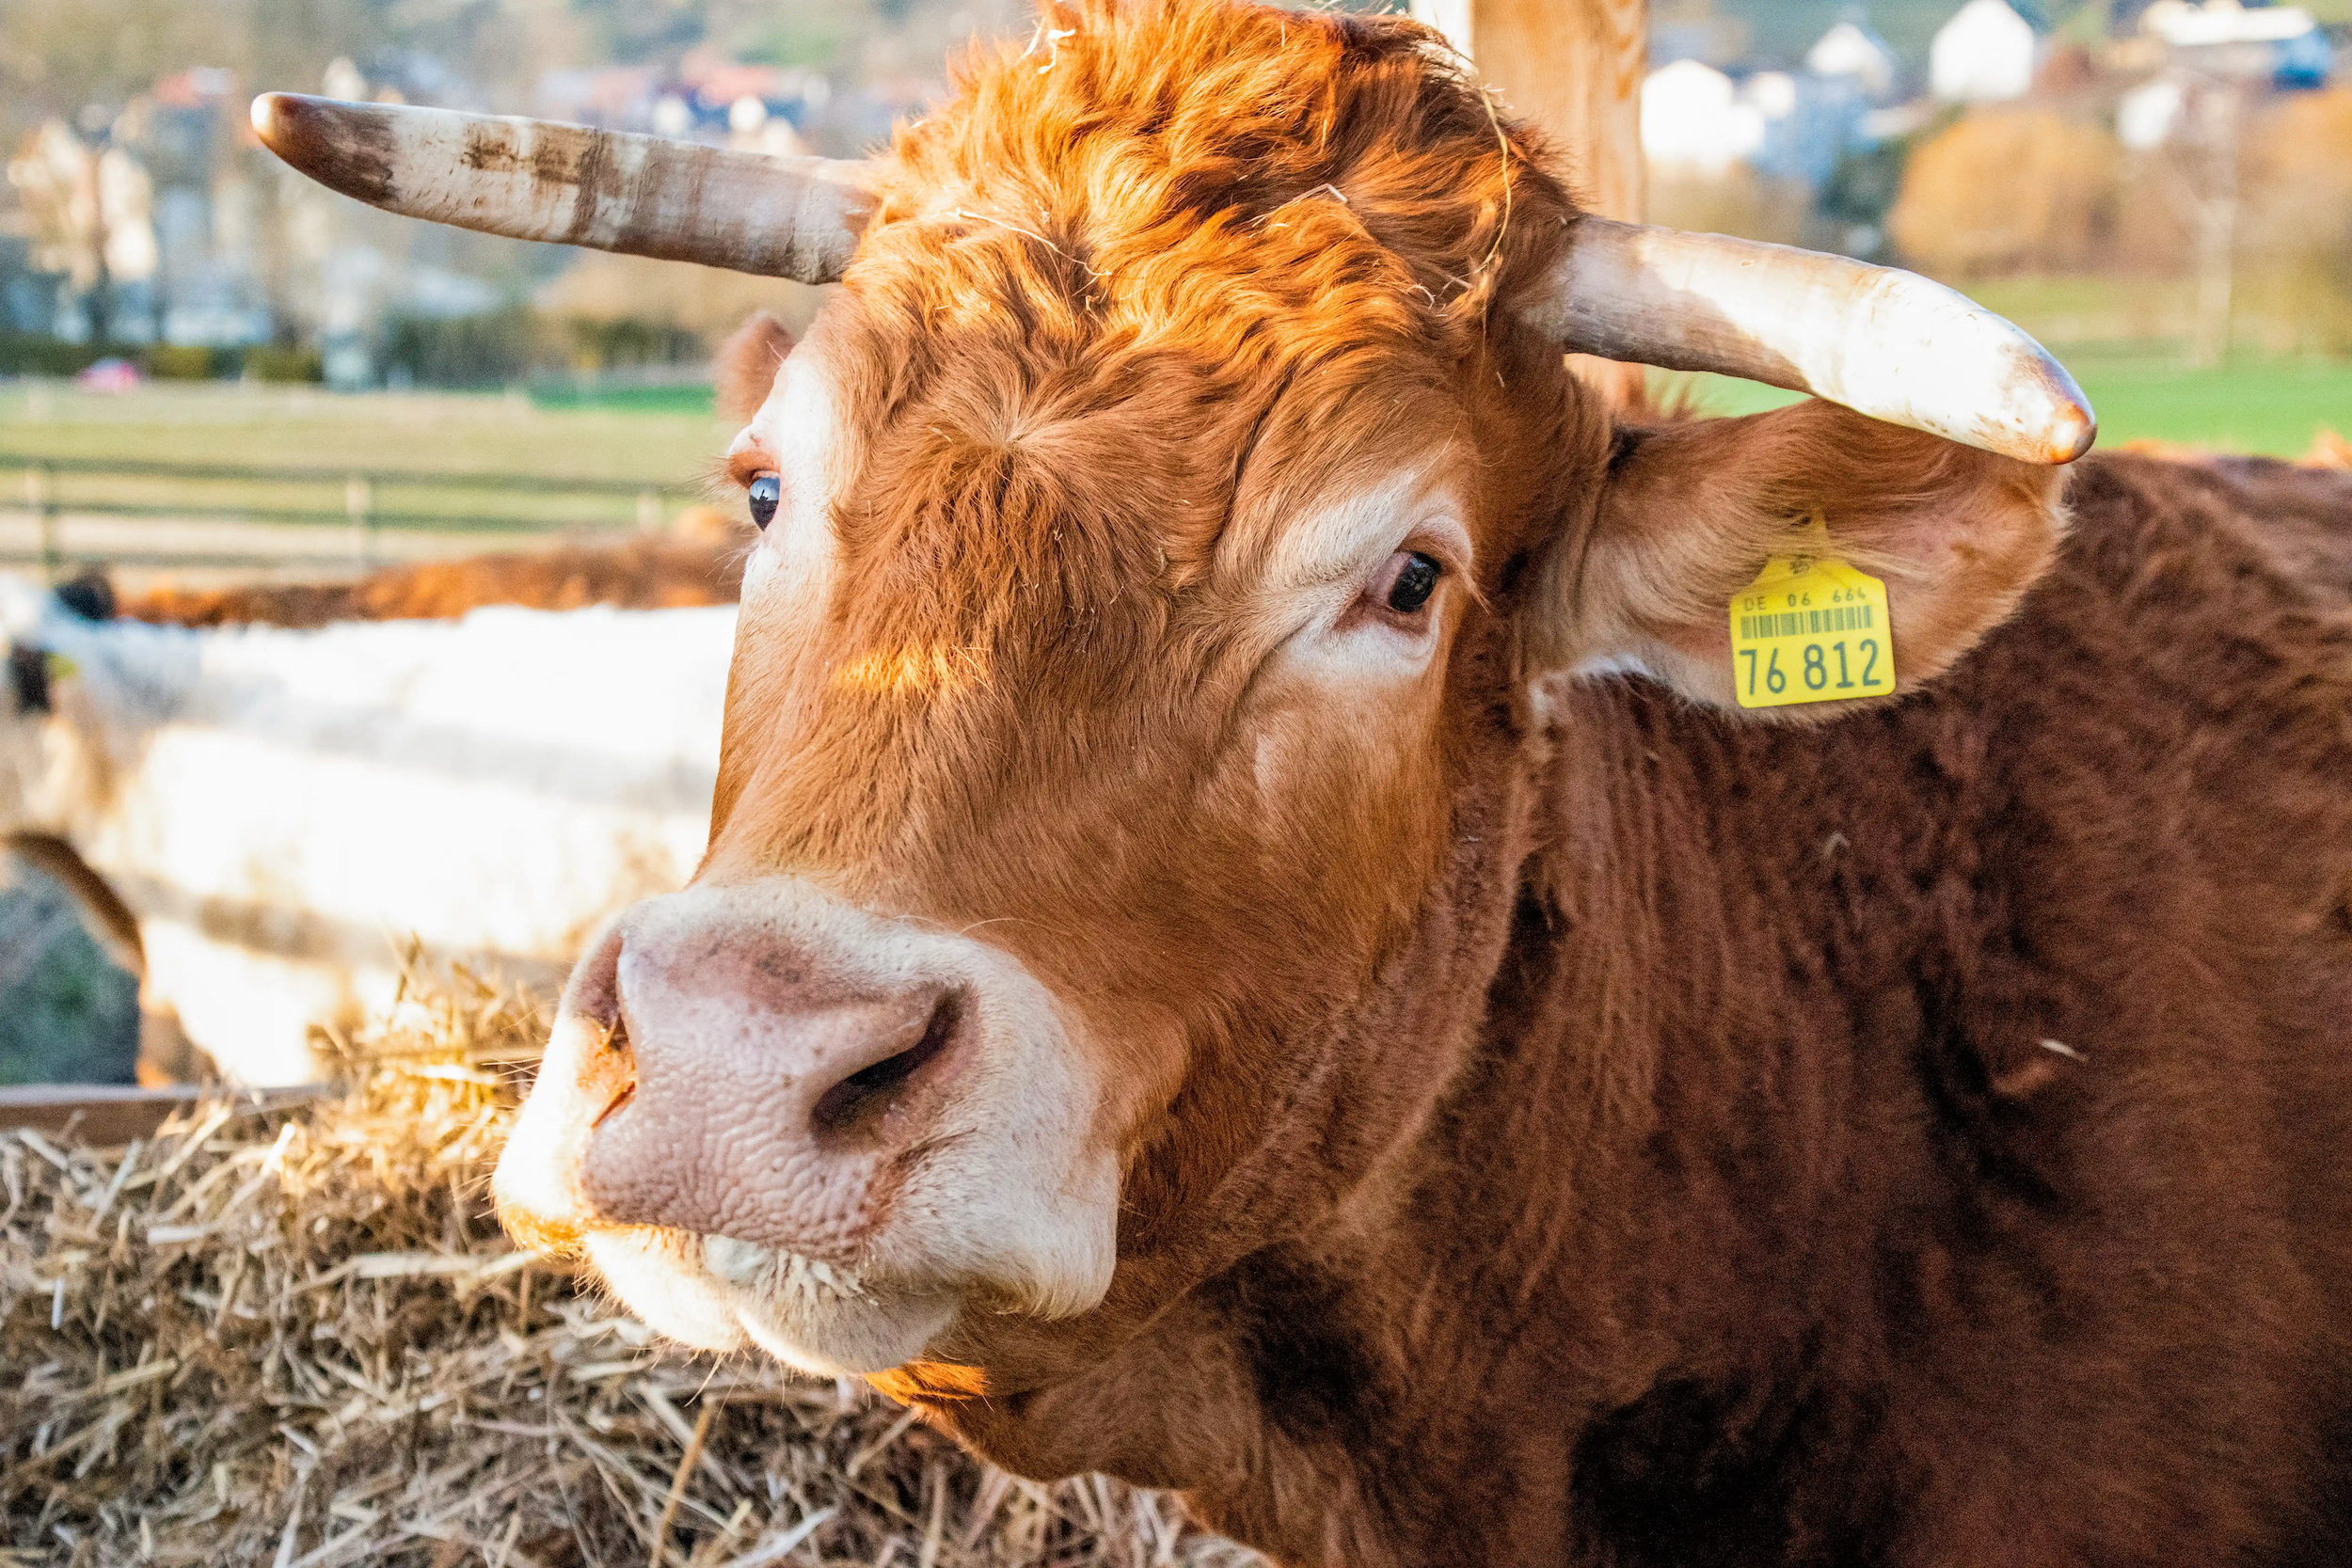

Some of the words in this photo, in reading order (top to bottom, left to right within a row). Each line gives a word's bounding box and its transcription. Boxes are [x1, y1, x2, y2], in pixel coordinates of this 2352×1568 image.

[1743, 596, 1767, 611] DE
[1788, 593, 1811, 608] 06
[1833, 586, 1867, 603] 664
[1739, 647, 1787, 696] 76
[1804, 639, 1882, 690] 812
